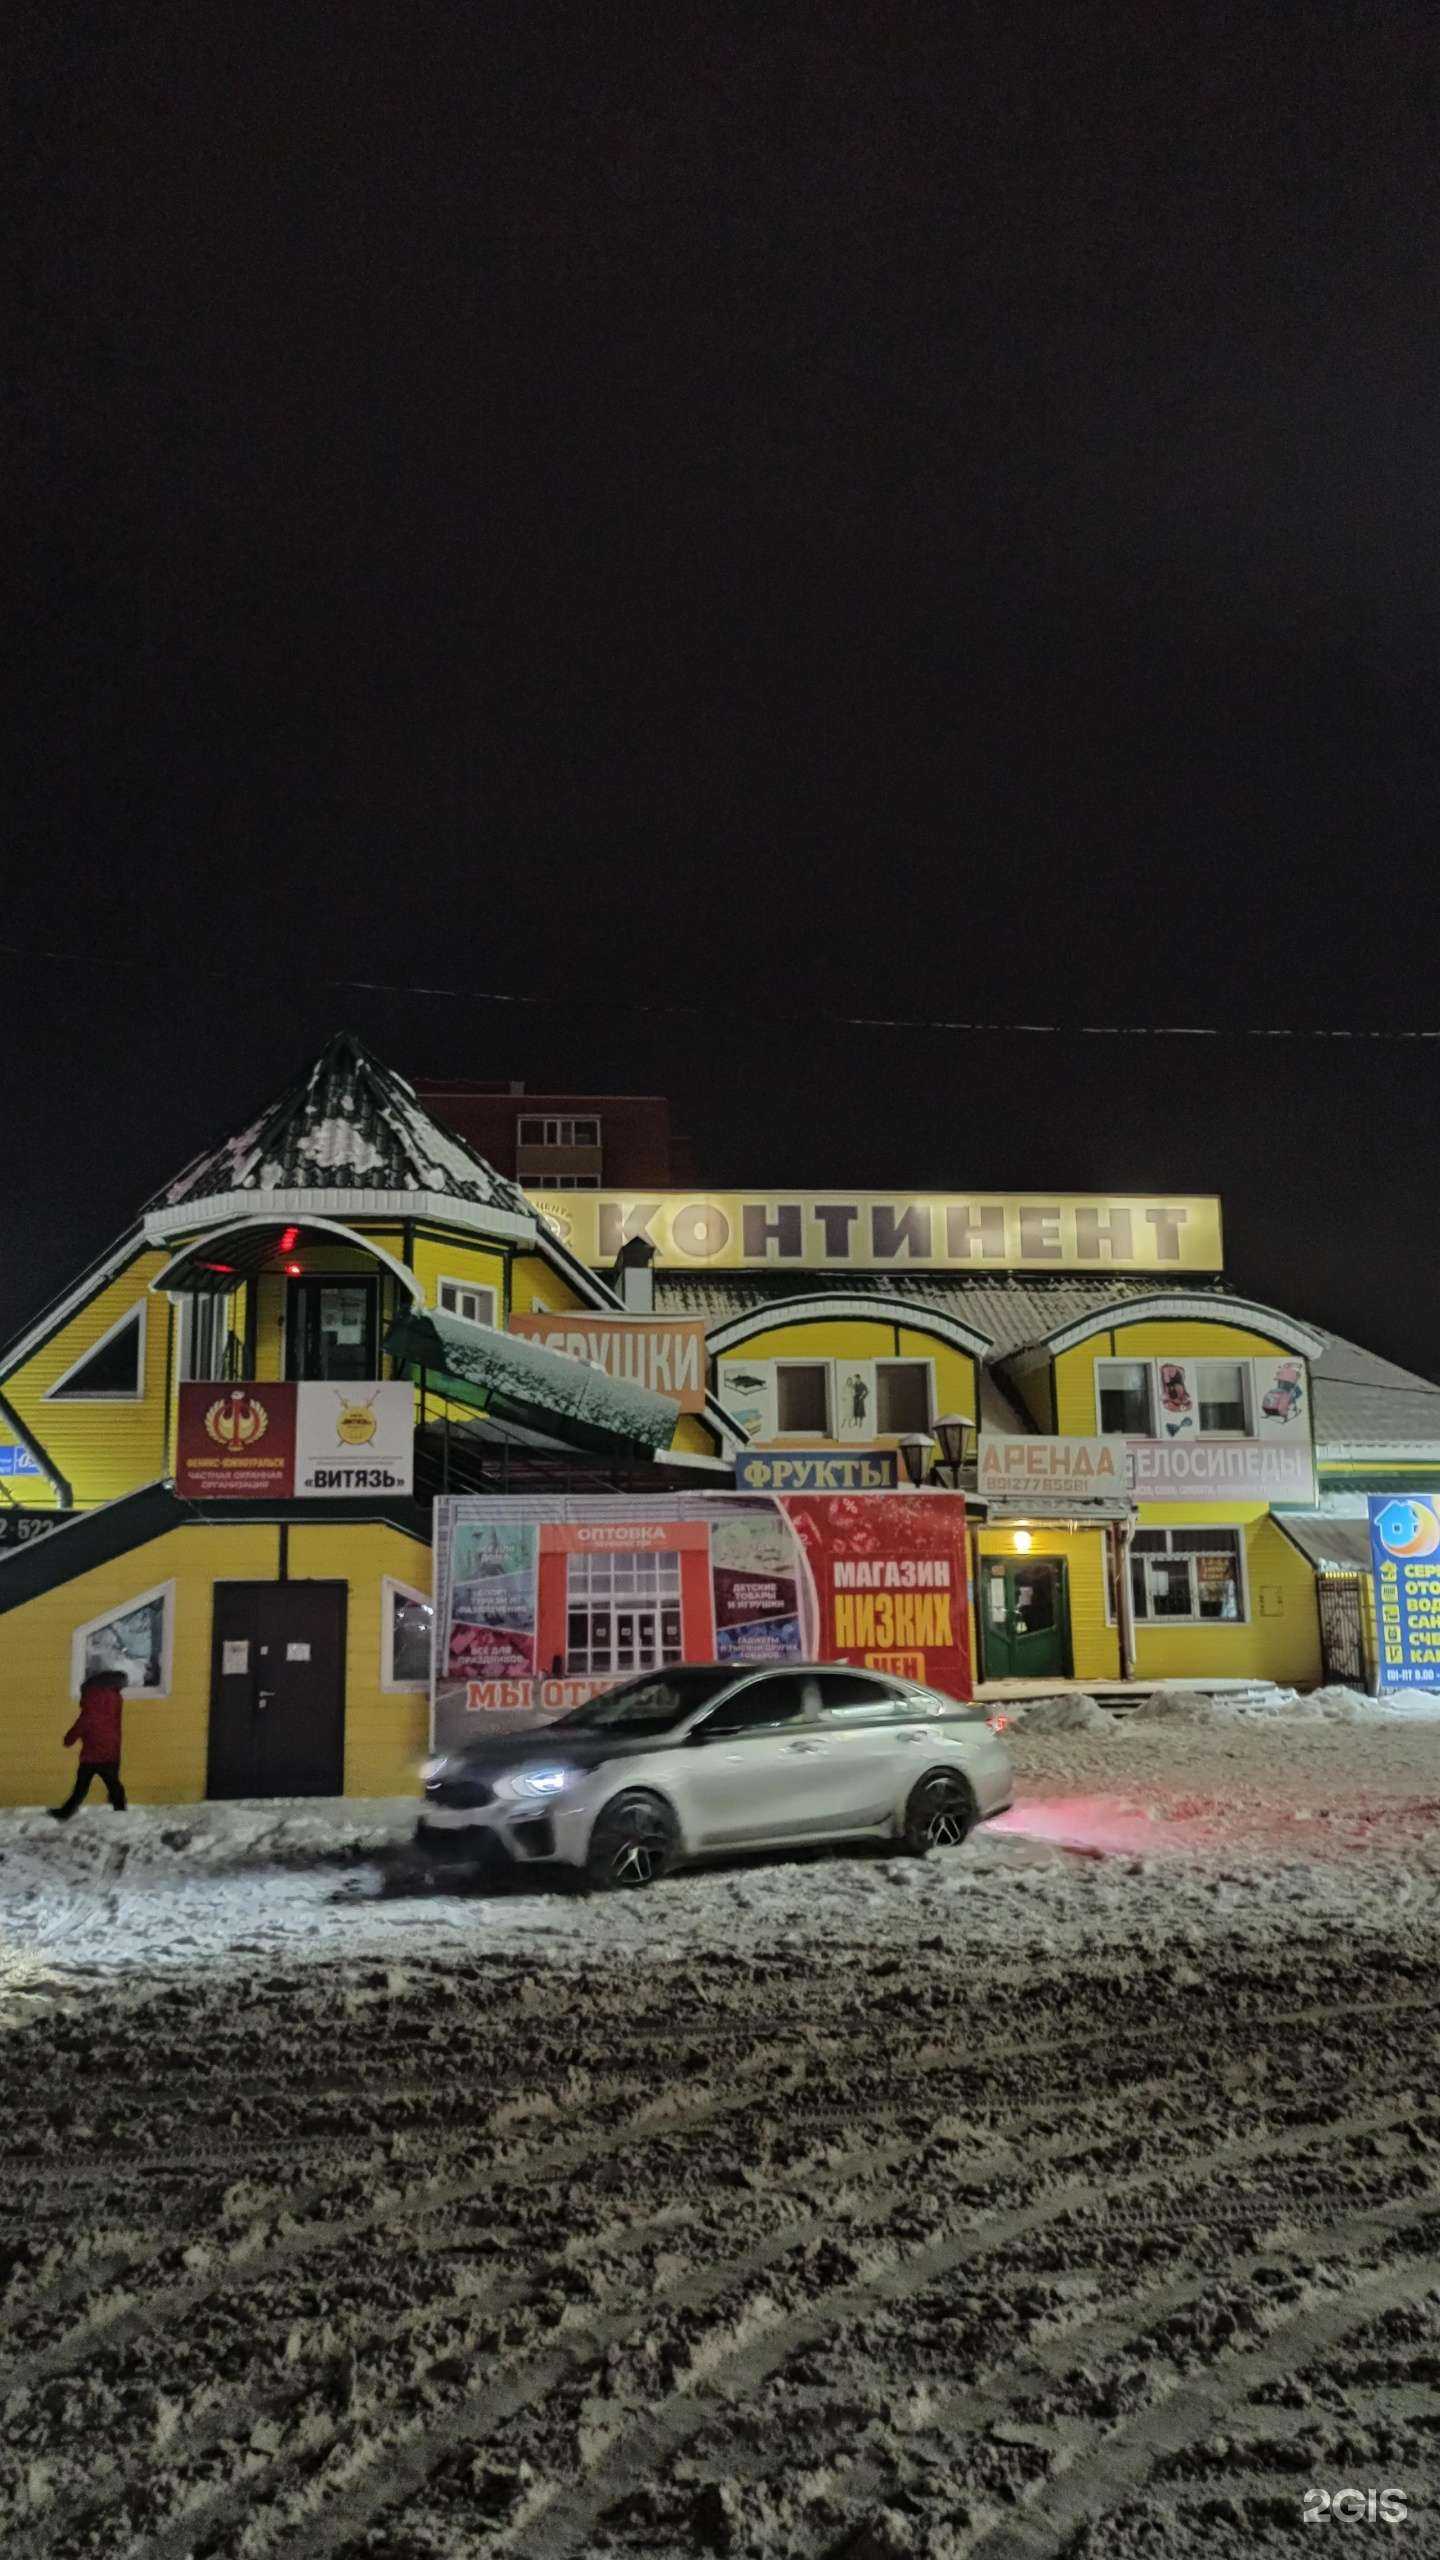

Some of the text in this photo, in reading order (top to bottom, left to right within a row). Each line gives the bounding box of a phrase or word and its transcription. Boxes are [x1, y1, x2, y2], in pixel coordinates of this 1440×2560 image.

[598, 1203, 1188, 1260] КОНТИНЕНТ
[982, 1444, 1115, 1477] АРЕНДА
[187, 1471, 283, 1480] ЧАСТНАЯ ОХРАННАЯ
[304, 1470, 405, 1488] «ВИТЯЗЬ»
[743, 1460, 891, 1488] ФРУКТЫ
[200, 1481, 270, 1490] ОРГАНИЗАЦИЯ
[576, 1526, 667, 1541] ОПТОВКА
[833, 1560, 951, 1589] МАГАЗИН
[732, 1582, 778, 1593] ДЕТСКИЕ
[735, 1591, 777, 1601] ТОВАРЫ
[727, 1600, 785, 1610] И ИГРУШКИ
[834, 1592, 954, 1648] НИЗКИХ
[458, 1655, 524, 1665] ПРАЗДНИКОВ
[467, 1680, 533, 1711] МЫ
